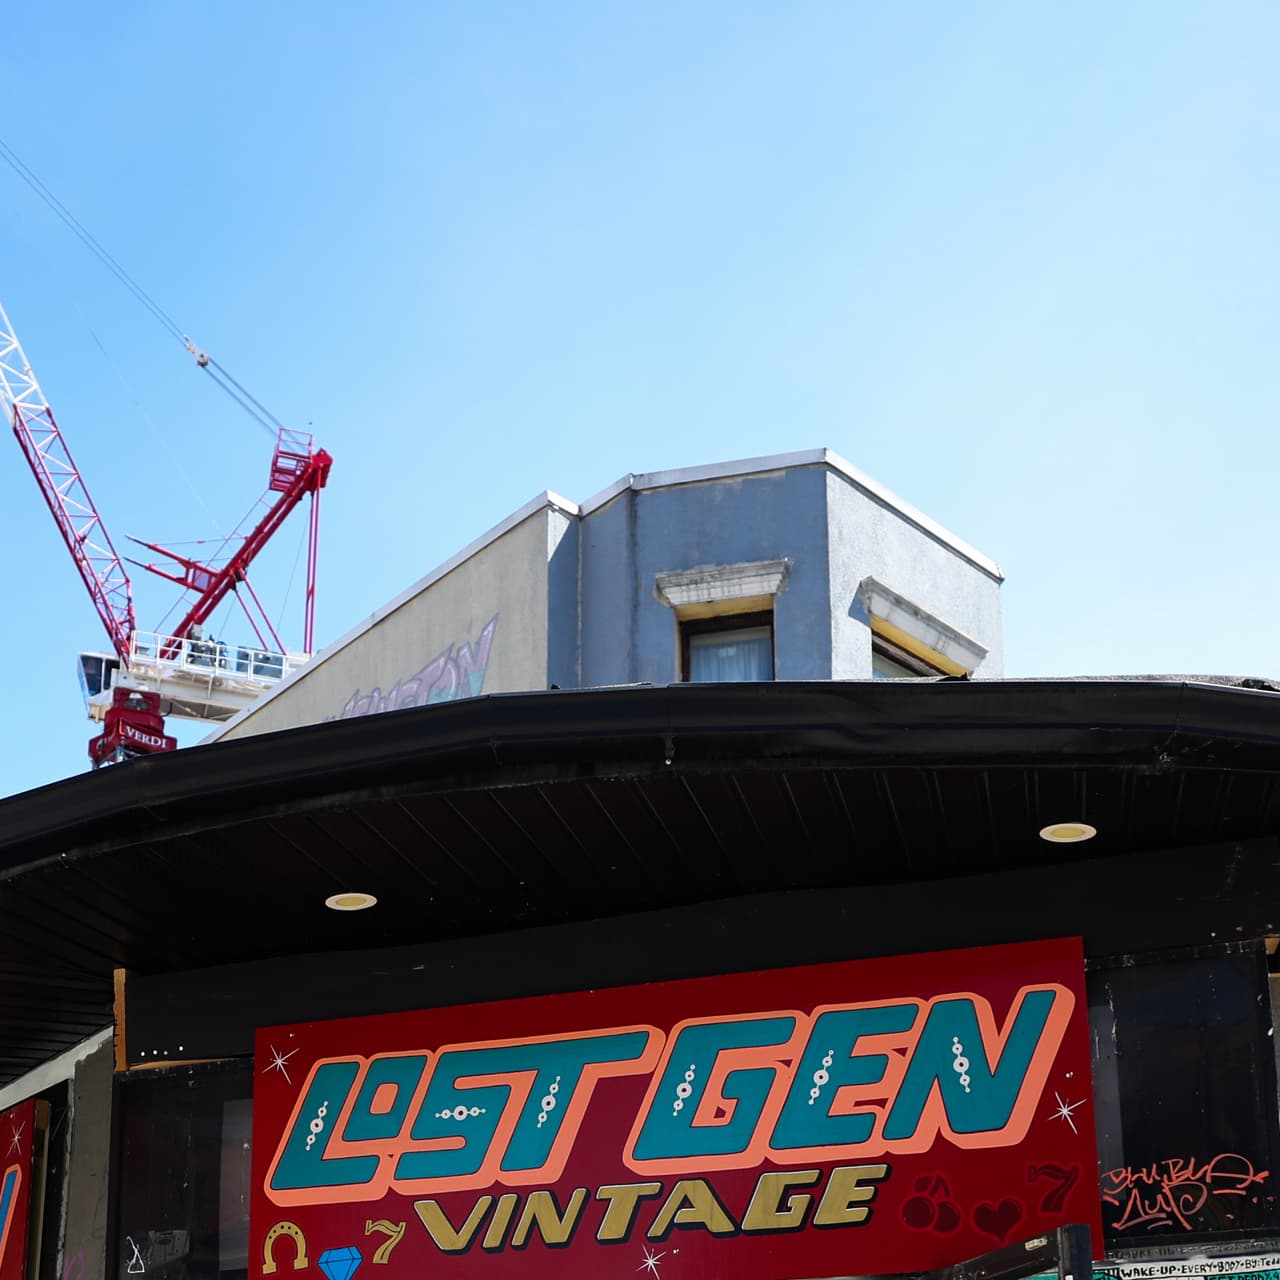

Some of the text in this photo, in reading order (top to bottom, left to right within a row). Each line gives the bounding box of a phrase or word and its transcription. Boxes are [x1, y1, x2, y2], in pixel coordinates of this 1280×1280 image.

[125, 724, 167, 750] VERDI
[264, 983, 1076, 1207] LOST GEN
[413, 1163, 892, 1254] VINTAGE
[1121, 1267, 1156, 1278] WAKE
[1160, 1266, 1177, 1275] UP
